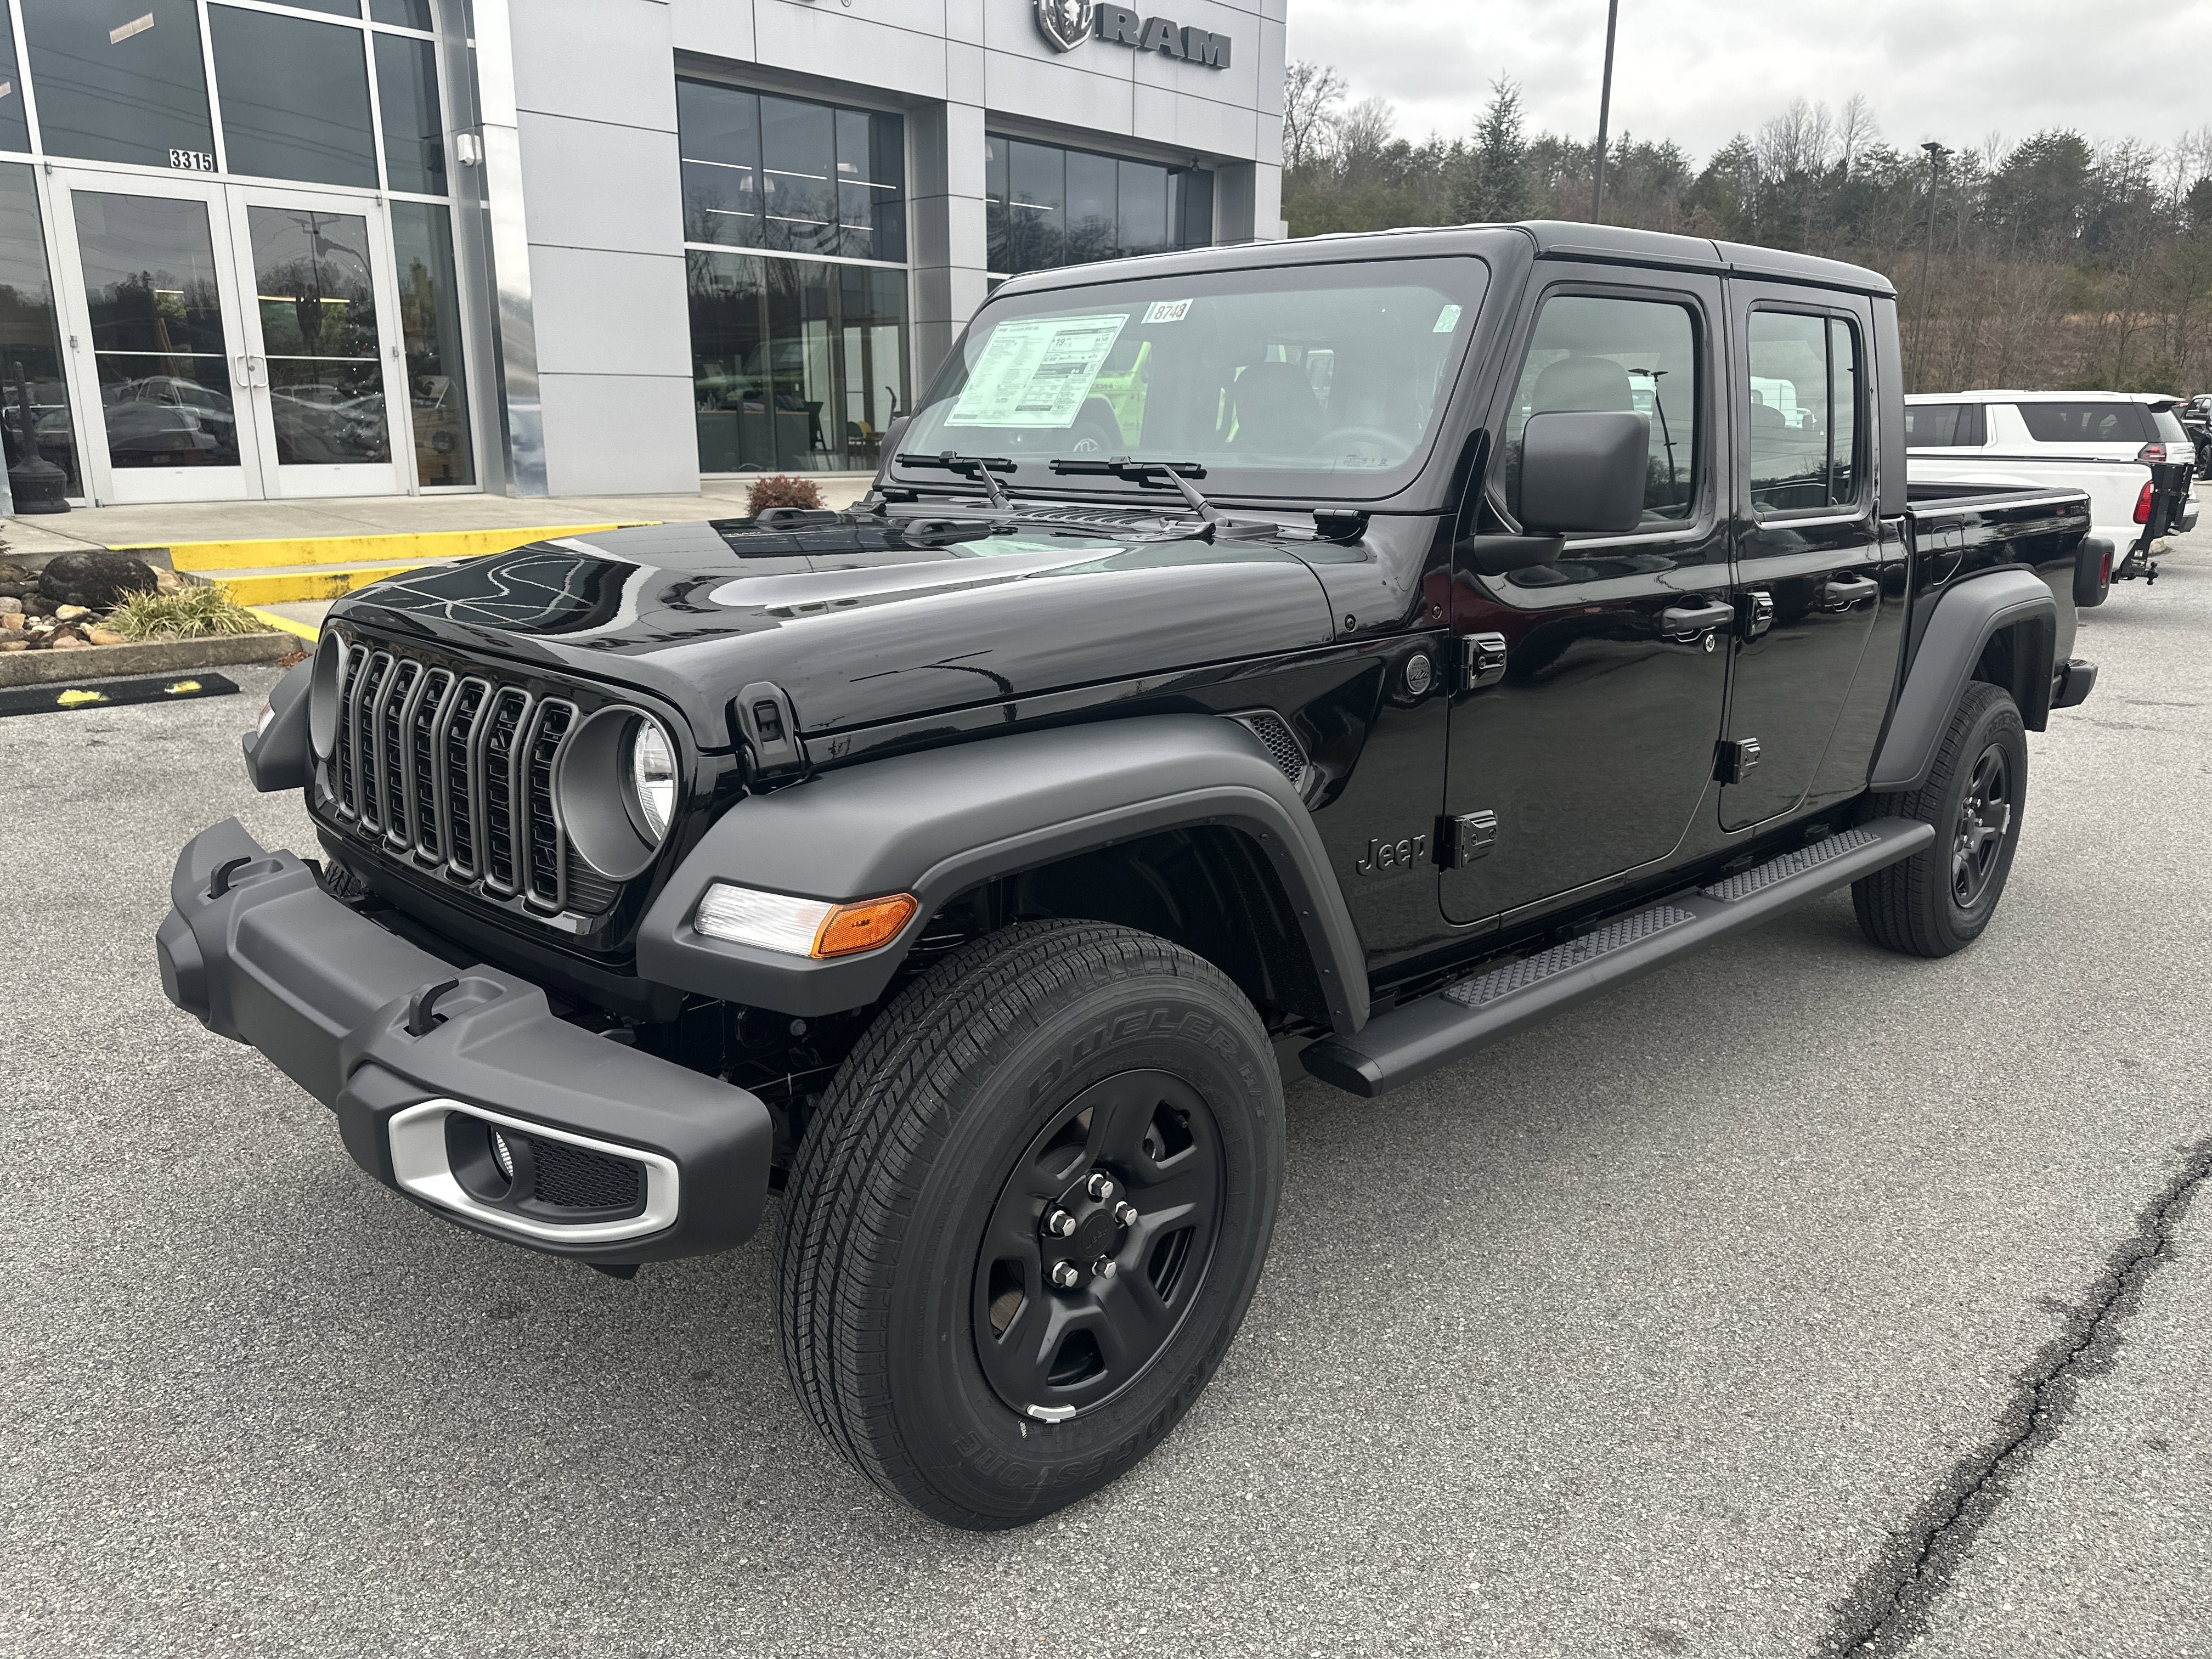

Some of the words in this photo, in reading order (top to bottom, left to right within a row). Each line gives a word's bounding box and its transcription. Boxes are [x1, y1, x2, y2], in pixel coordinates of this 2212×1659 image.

[1097, 2, 1232, 69] RAM
[172, 150, 212, 171] 3315
[1154, 303, 1187, 320] 8748
[1056, 338, 1066, 346] 19
[1356, 834, 1426, 876] Jeep
[1027, 1007, 1241, 1110] DUELER
[1086, 1224, 1109, 1249] Jeep
[953, 1321, 1231, 1511] BRIDGESTONE
